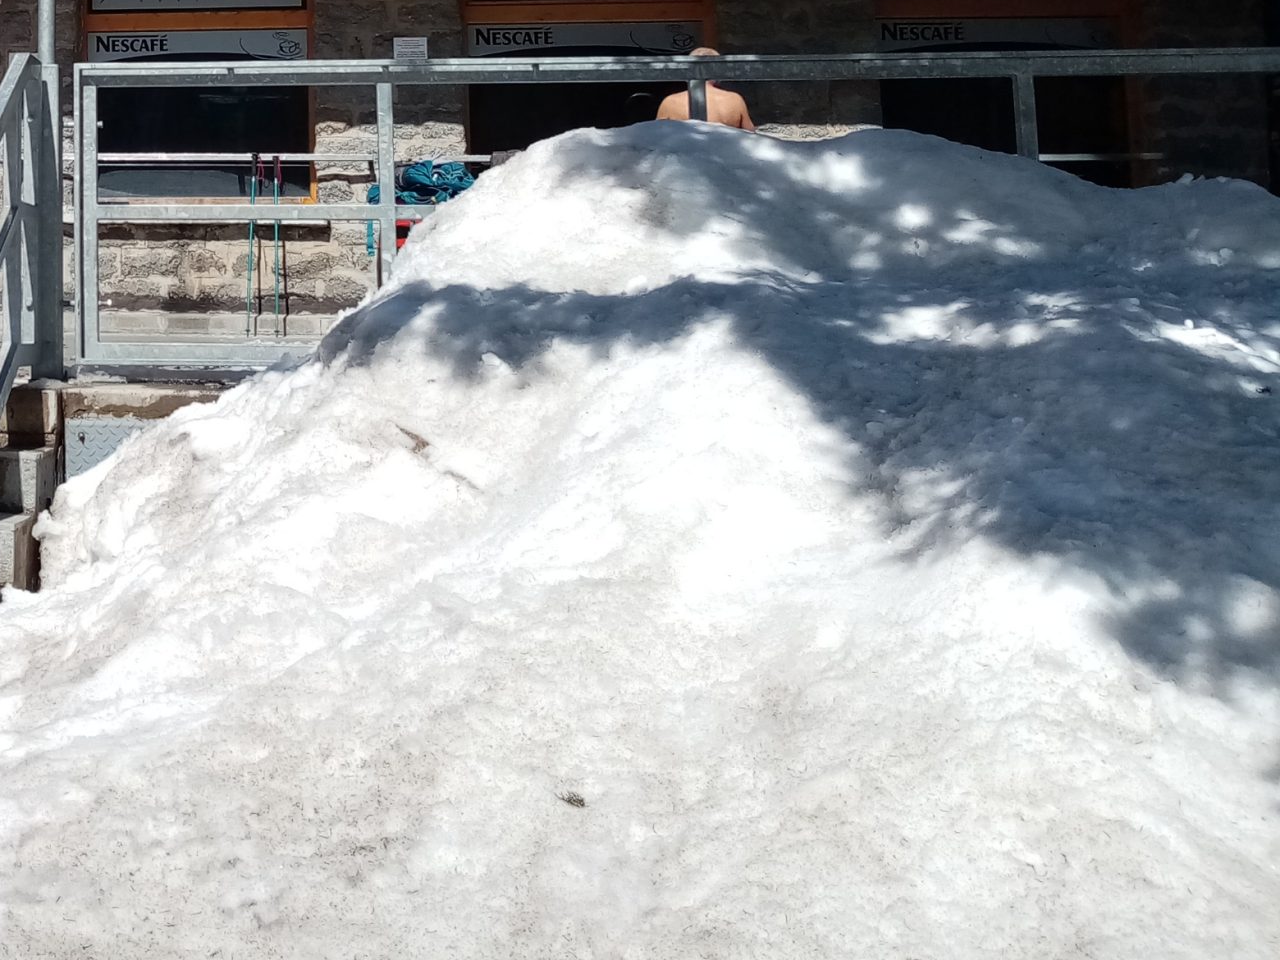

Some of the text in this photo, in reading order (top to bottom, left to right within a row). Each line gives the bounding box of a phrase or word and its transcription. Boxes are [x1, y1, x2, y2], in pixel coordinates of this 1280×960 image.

[474, 26, 554, 46] NESCAFÉ
[880, 21, 965, 42] NESCAFÉ
[95, 33, 169, 54] NESCAFÉ
